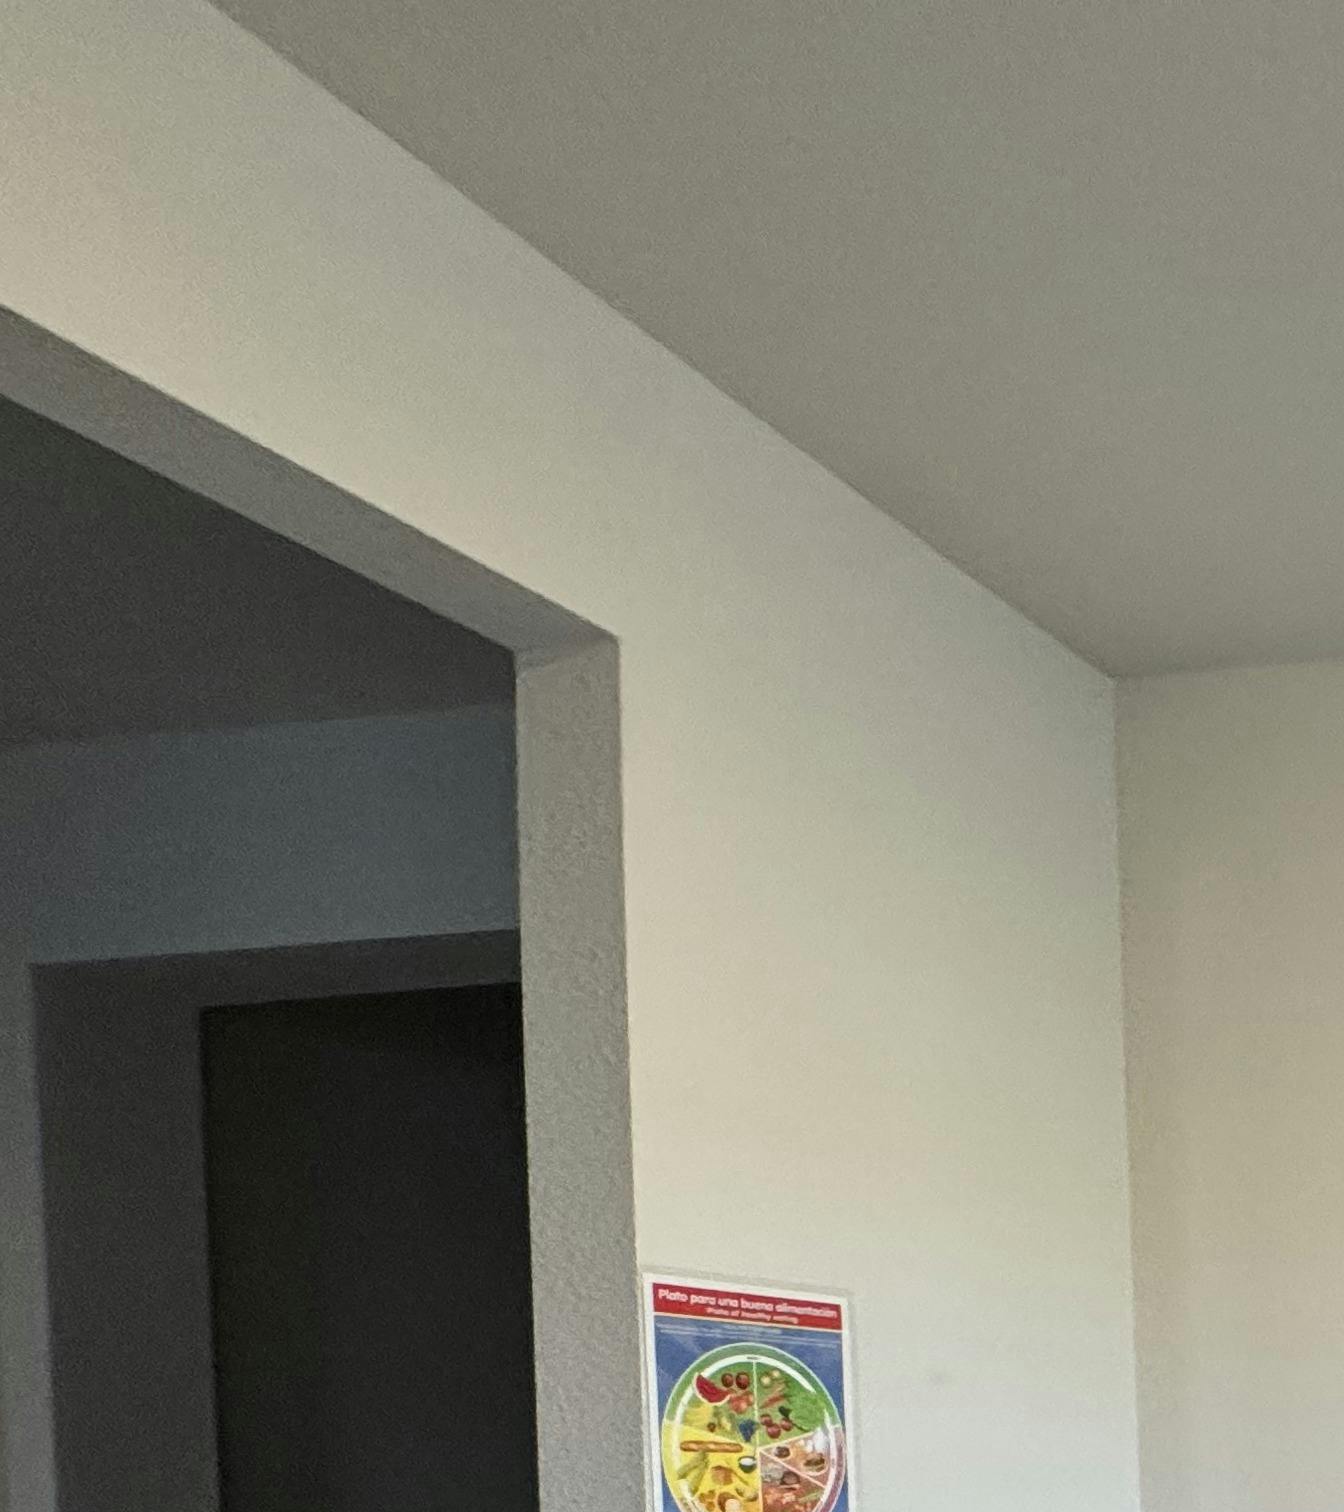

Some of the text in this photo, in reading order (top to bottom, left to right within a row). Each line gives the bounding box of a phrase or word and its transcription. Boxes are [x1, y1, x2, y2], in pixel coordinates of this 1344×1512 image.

[658, 1289, 688, 1302] Plato
[690, 1294, 716, 1305] para
[718, 1298, 739, 1307] una
[740, 1299, 773, 1312] buena
